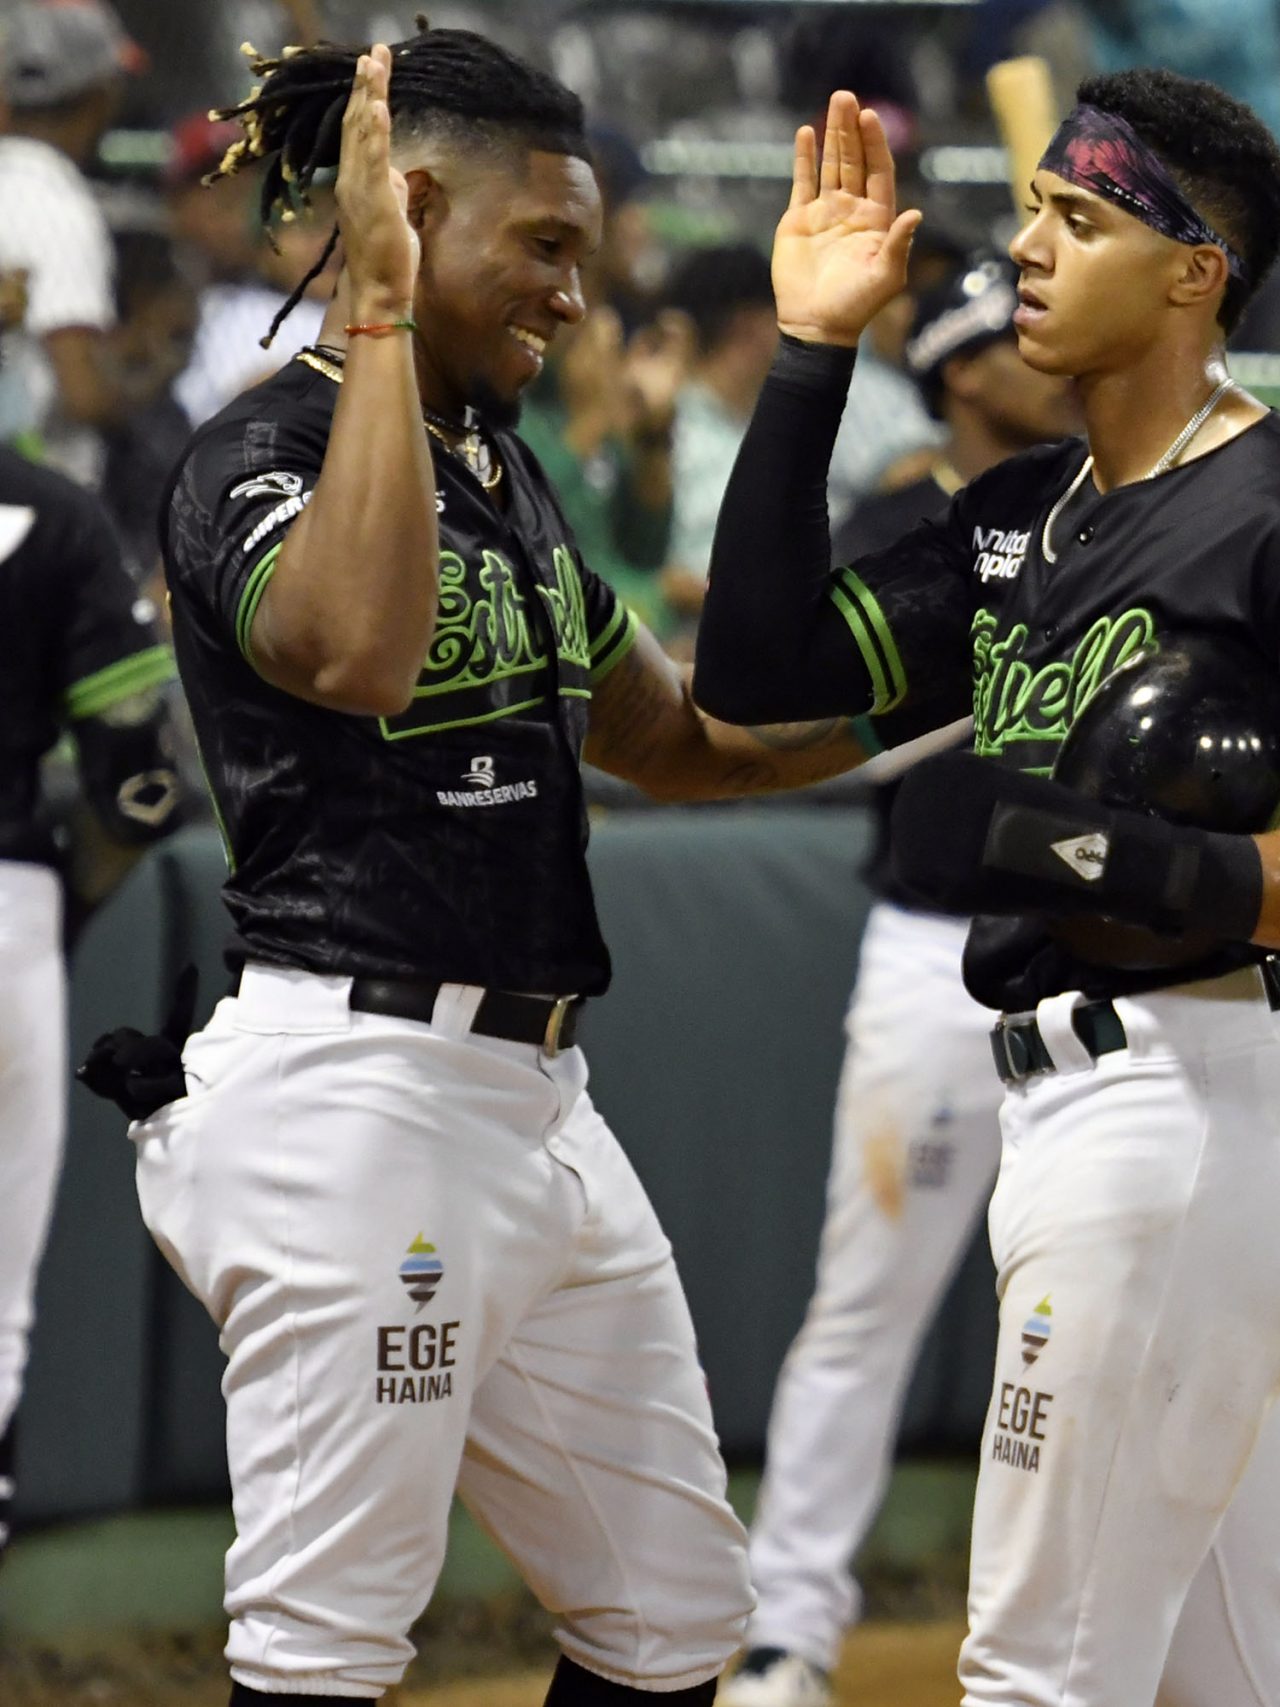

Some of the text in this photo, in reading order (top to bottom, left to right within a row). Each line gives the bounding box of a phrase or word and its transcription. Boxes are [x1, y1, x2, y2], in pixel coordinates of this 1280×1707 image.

[436, 780, 538, 807] BANRESERVAS
[376, 1320, 461, 1371] EGE
[375, 1372, 452, 1404] HAINA
[997, 1382, 1054, 1441] EGE
[992, 1434, 1040, 1474] HAINA
